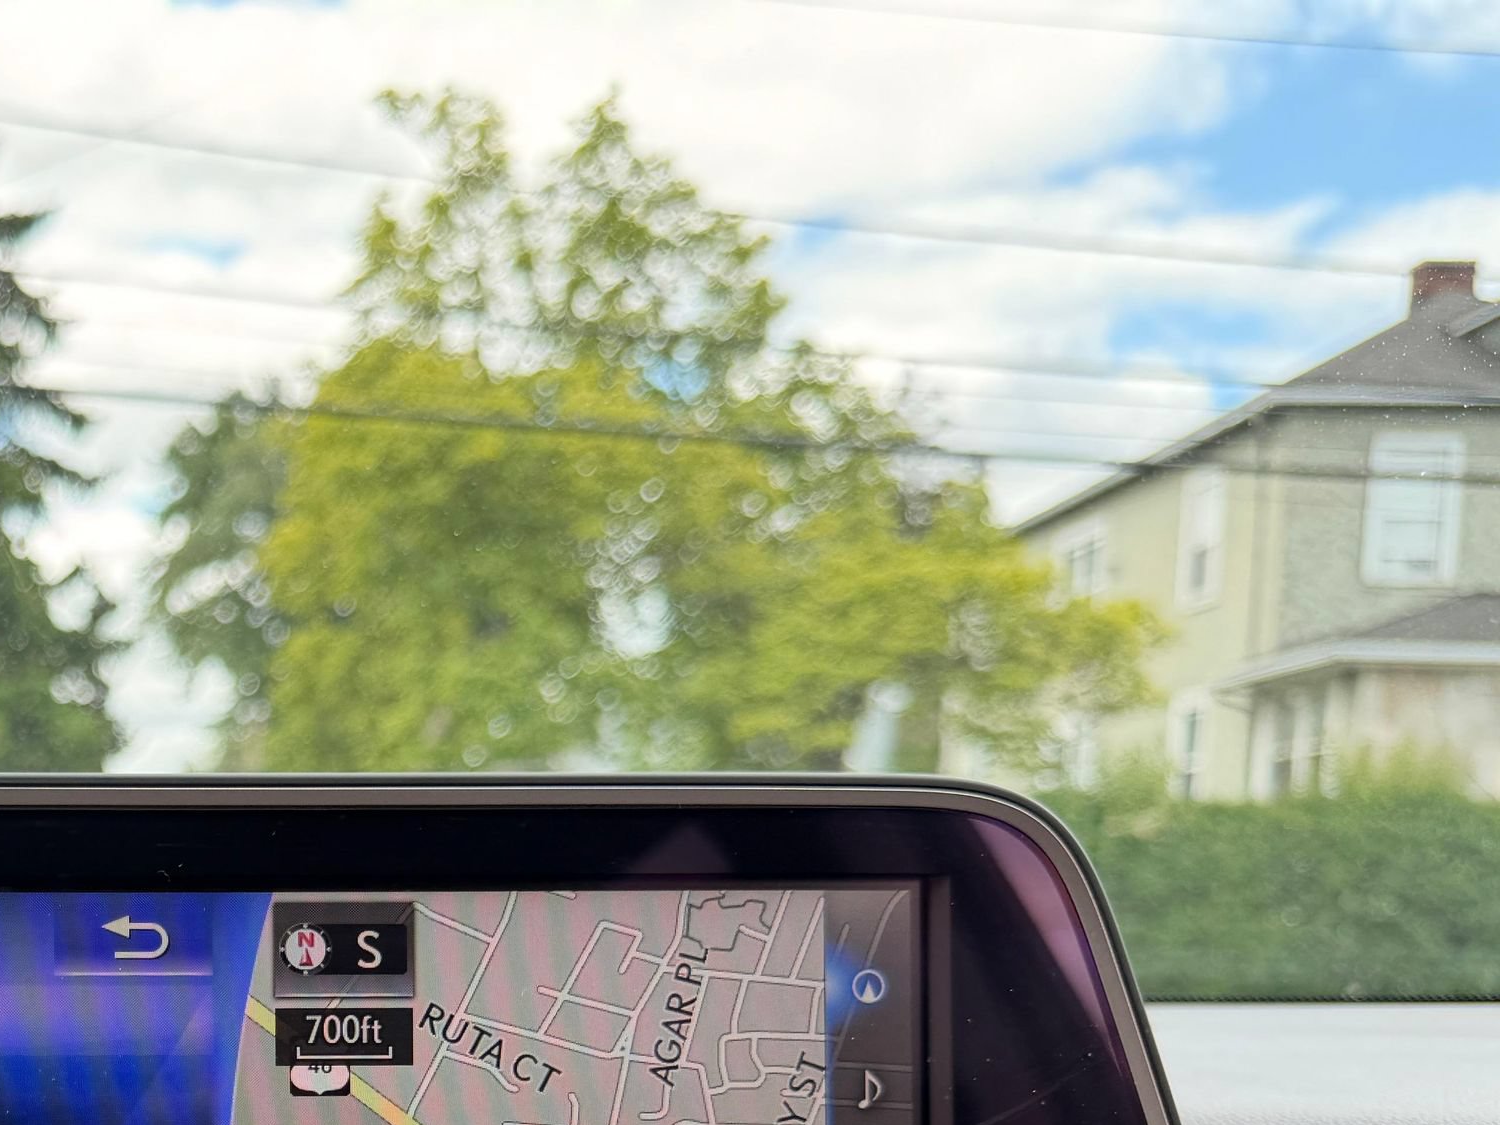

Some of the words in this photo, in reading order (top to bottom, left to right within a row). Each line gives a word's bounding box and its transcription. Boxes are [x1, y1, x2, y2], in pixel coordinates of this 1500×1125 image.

[297, 931, 314, 948] N
[356, 930, 382, 970] S
[305, 1014, 383, 1045] 700ft
[649, 992, 697, 1088] AGAR
[674, 948, 709, 986] PL
[418, 1002, 505, 1070] RUTA
[512, 1053, 563, 1094] CT
[789, 1051, 827, 1099] ST
